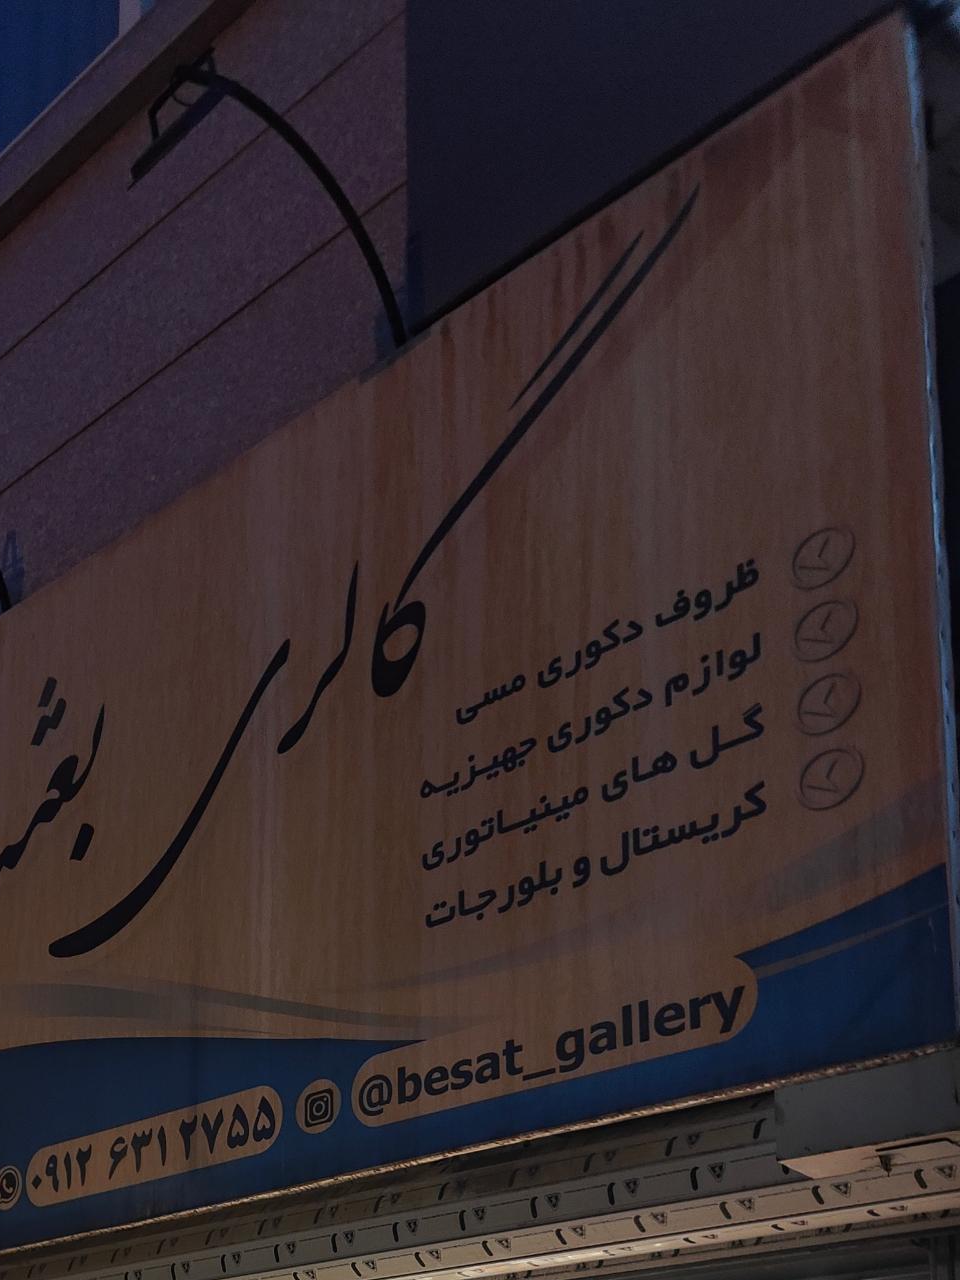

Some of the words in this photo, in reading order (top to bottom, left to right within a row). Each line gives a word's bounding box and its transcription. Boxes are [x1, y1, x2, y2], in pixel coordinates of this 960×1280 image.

[655, 559, 759, 628] ظروف
[538, 619, 642, 688] دکوری
[666, 633, 761, 706] لوازم
[456, 674, 525, 724] مسی
[548, 687, 652, 752] دکوری
[420, 737, 536, 798] جهیزیه
[691, 704, 764, 768] گل
[602, 751, 676, 802] های
[423, 787, 588, 870] مینیاتوری
[601, 782, 766, 876] کریستال
[426, 862, 562, 928] بلورجات
[573, 857, 590, 886] و
[359, 984, 744, 1117] @besat_gallery
